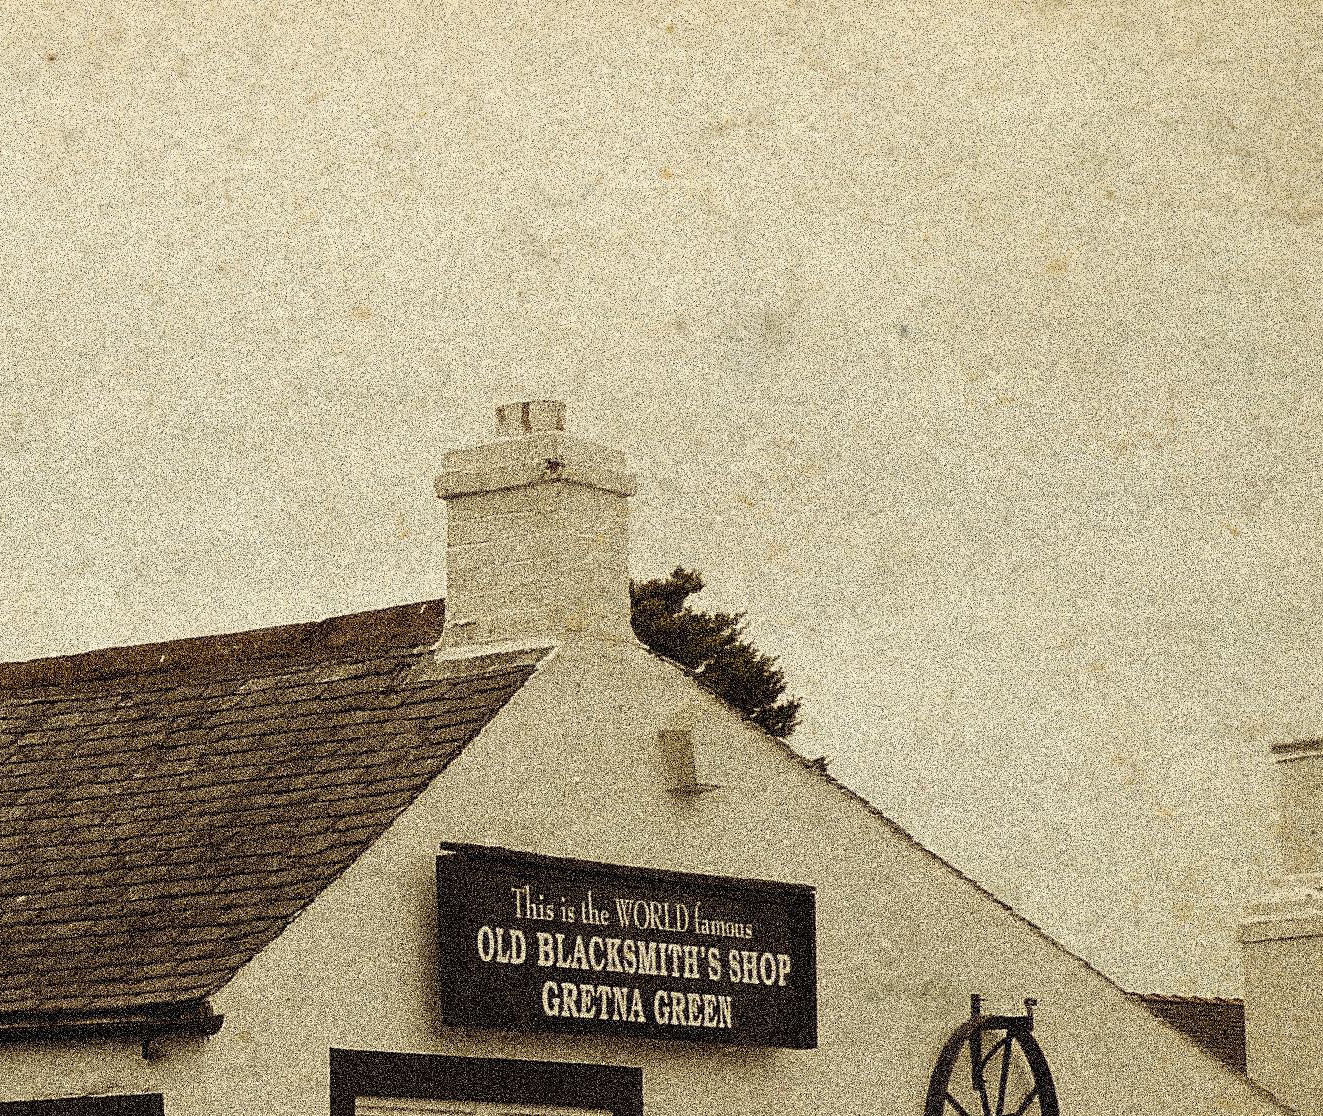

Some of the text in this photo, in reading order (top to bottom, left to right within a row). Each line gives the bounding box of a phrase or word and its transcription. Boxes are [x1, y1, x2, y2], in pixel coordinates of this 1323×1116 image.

[511, 885, 753, 939] This is the WORLD famous
[477, 926, 791, 986] OLD BLACKSMITH'S SHOP
[541, 981, 733, 1029] GRETNA GREEN
